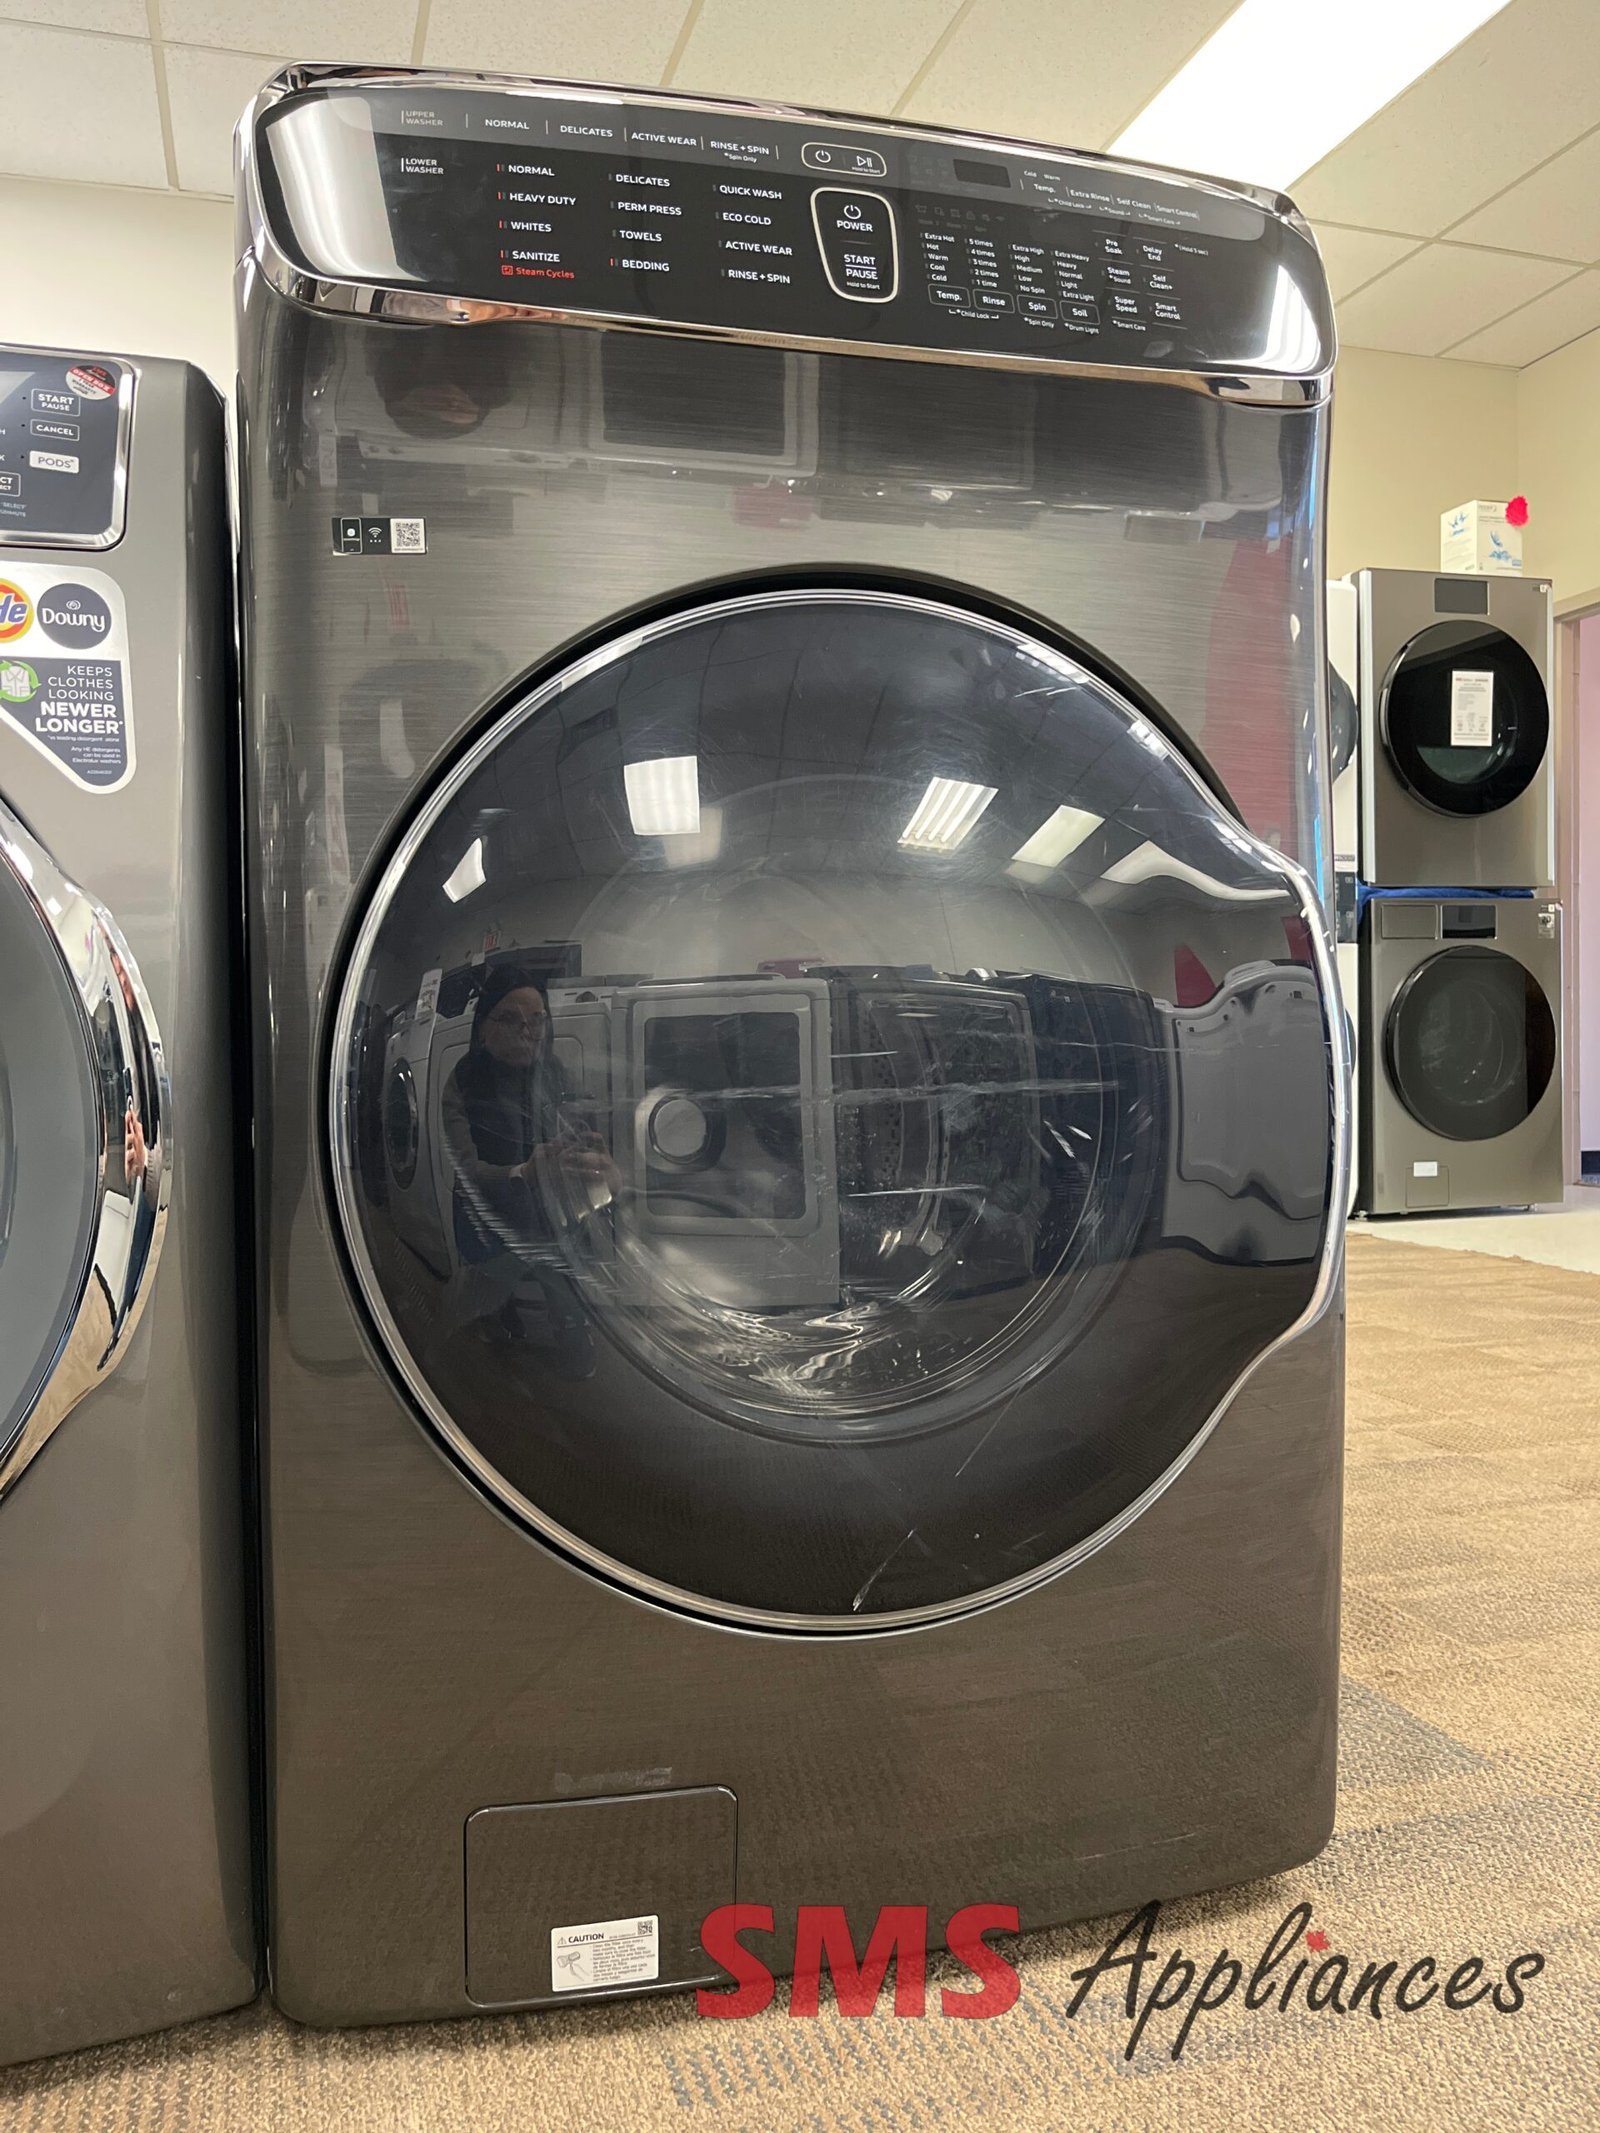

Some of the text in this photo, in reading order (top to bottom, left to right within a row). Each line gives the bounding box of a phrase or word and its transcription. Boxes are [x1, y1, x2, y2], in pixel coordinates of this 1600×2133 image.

[406, 110, 435, 118] UPPER
[406, 118, 444, 126] WASHER
[485, 119, 530, 130] NORMAL
[560, 125, 613, 137] DELICATES
[631, 132, 697, 146] ACTIVE WEAR
[710, 141, 739, 152] RINSE
[747, 145, 770, 155] SPIN
[406, 158, 438, 166] LOWER
[406, 166, 444, 175] WASHER
[508, 164, 555, 176] NORMAL
[616, 174, 671, 187] DELICATES
[719, 184, 782, 200] QUICK WASH
[1033, 183, 1056, 193] Temp.
[509, 193, 576, 206] HEAVY DUTY
[1090, 193, 1110, 202] Rinse
[618, 202, 682, 216] PERM PRESS
[723, 212, 772, 225] ECO COLD
[511, 221, 552, 232] WHITES
[837, 220, 873, 232] POWER
[620, 230, 663, 242] TOWELS
[925, 232, 955, 243] Extra Hot
[725, 241, 793, 255] ACTIVE WEAR
[974, 239, 993, 248] times
[1105, 239, 1118, 247] Pre
[976, 249, 995, 257] times
[1012, 244, 1044, 255] Extra High
[1105, 246, 1122, 255] Soak
[1143, 245, 1162, 256] Delay
[512, 250, 561, 263] SANITIZE
[844, 254, 876, 265] START
[928, 253, 949, 261] Warm
[1014, 254, 1030, 262] High
[1055, 250, 1089, 262] Extra Heavy
[622, 259, 670, 272] BEDDING
[978, 259, 997, 268] times
[1016, 264, 1043, 273] Medium
[1057, 261, 1077, 270] Heavy
[515, 267, 575, 280] Steam Cycles
[728, 269, 758, 280] RINSE
[767, 274, 791, 284] SPIN
[846, 269, 878, 280] PAUSE
[980, 270, 999, 278] times
[1059, 271, 1083, 280] Normal
[1107, 267, 1130, 276] Steam
[931, 274, 947, 282] Cold
[1018, 274, 1032, 282] Low
[1152, 274, 1166, 283] Self
[981, 280, 997, 288] time
[1020, 285, 1045, 294] No Spin
[1061, 281, 1078, 289] Light
[936, 290, 962, 302] Temp.
[982, 296, 1006, 306] Rinse
[1063, 291, 1095, 302] Extra Light
[1114, 296, 1135, 305] Super
[1028, 302, 1047, 312] Spin
[1072, 308, 1088, 317] Soil
[1115, 304, 1138, 313] Speed
[1155, 302, 1177, 312] Smart
[1155, 310, 1181, 320] Control
[38, 393, 74, 405] START
[42, 402, 70, 412] PAUSE
[36, 424, 74, 436] CANCEL
[42, 608, 105, 632] Downy
[67, 665, 112, 677] KEEPS
[48, 677, 113, 689] CLOTHES
[48, 689, 114, 701] LOOKING
[40, 702, 117, 718] NEWER
[568, 1933, 604, 1944] CAUTION
